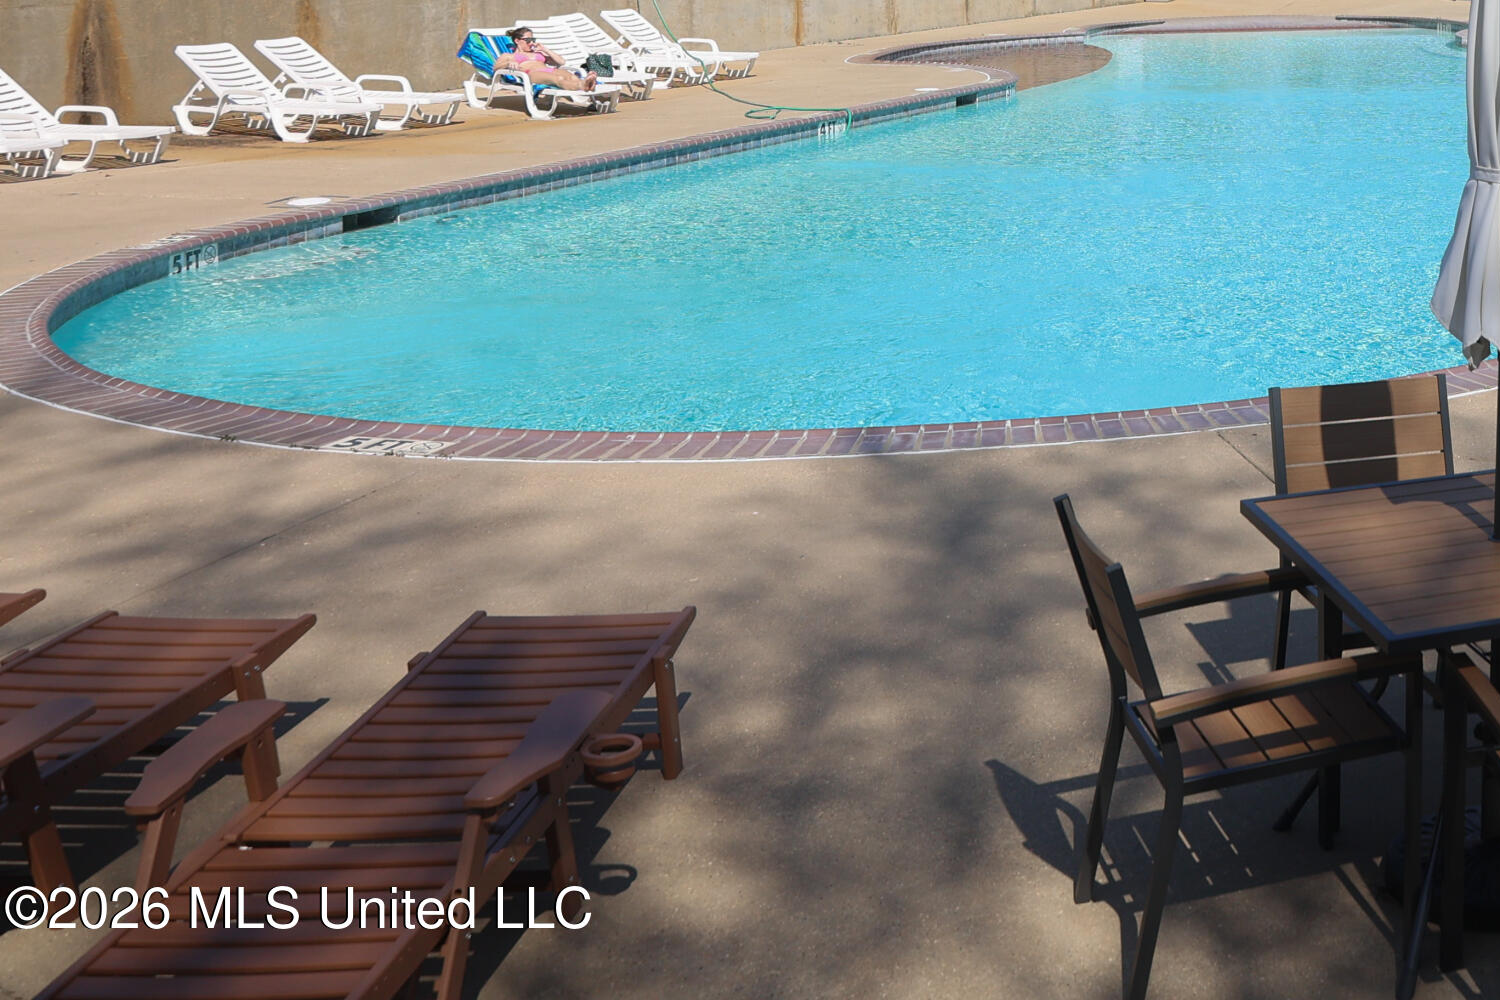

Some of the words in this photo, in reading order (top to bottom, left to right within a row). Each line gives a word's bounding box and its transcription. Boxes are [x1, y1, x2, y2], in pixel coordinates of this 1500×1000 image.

[820, 122, 826, 135] 4
[172, 254, 182, 275] 5
[186, 249, 201, 270] FT
[332, 437, 371, 448] 5
[362, 439, 414, 450] FT
